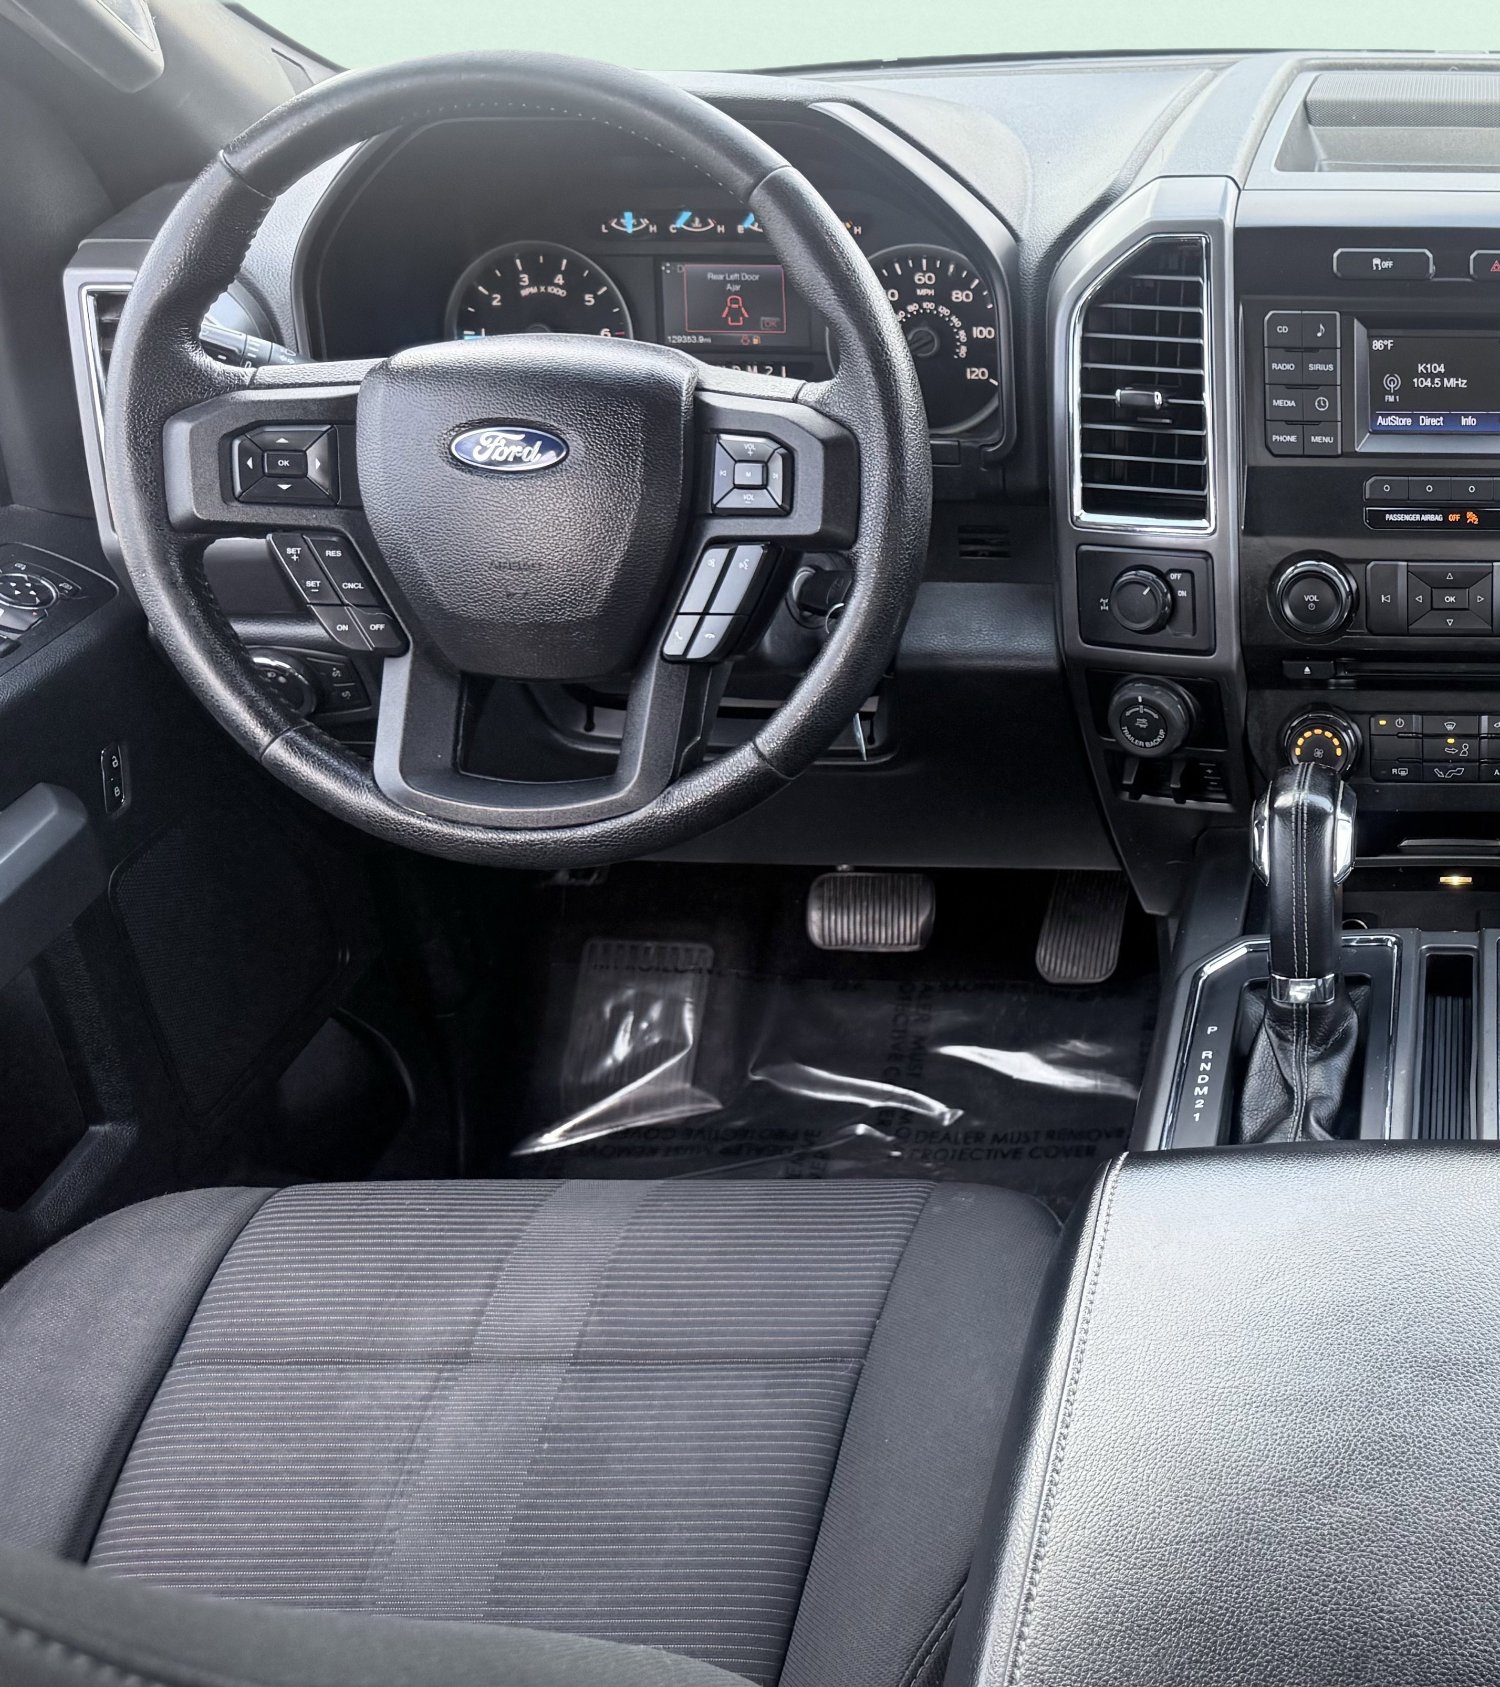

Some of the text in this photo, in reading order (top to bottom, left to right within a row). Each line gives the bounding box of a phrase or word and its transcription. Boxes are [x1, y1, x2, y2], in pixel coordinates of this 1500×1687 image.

[649, 225, 657, 233] H
[717, 225, 725, 233] H
[853, 226, 862, 235] H
[1381, 261, 1393, 269] OFF
[519, 274, 529, 286] 3
[554, 274, 564, 285] 4
[707, 272, 760, 281] Rear Left Door
[914, 273, 936, 285] 60
[520, 286, 538, 297] RPM
[547, 286, 567, 298] 1000
[726, 283, 741, 292] Ajar
[491, 295, 502, 306] 2
[584, 295, 595, 306] 5
[951, 290, 973, 302] 80
[922, 302, 935, 310] 100
[937, 305, 951, 316] 120
[764, 319, 777, 328] OK
[600, 328, 611, 338] 6
[972, 327, 995, 339] 100
[1276, 325, 1289, 334] CD
[1372, 340, 1394, 350] 86°F
[1271, 363, 1295, 371] RADIO
[1308, 363, 1334, 371] SIRIUS
[1417, 363, 1446, 374] K104
[966, 368, 989, 380] 120
[1412, 377, 1468, 388] 104.5 MHz
[1272, 399, 1296, 407] MEDIA
[1376, 415, 1413, 426] AutStore
[1419, 415, 1444, 426] Direct
[1461, 415, 1477, 426] Info
[1272, 434, 1297, 442] PHONE
[1311, 436, 1334, 444] MENU
[472, 431, 544, 463] Ford
[278, 459, 290, 467] OK
[1385, 514, 1460, 522] PASSENGER AIRBAG OFF
[286, 547, 301, 555] SET
[306, 580, 321, 588] SET
[342, 582, 364, 590] CNCL
[1303, 594, 1319, 602] VOL
[1445, 595, 1456, 603] OK
[336, 624, 349, 632] ON
[369, 623, 385, 631] OFF
[1121, 725, 1166, 748] TRAILER BACKUP
[1207, 1026, 1218, 1035] P
[1201, 1051, 1213, 1059] R
[1200, 1062, 1211, 1071] N
[1197, 1074, 1209, 1084] D
[1194, 1086, 1208, 1095] M
[1195, 1099, 1205, 1108] 2
[1193, 1112, 1200, 1122] 1
[913, 1129, 985, 1145] DEALER
[988, 1128, 1042, 1145] MUST
[1029, 1145, 1097, 1159] COVER
